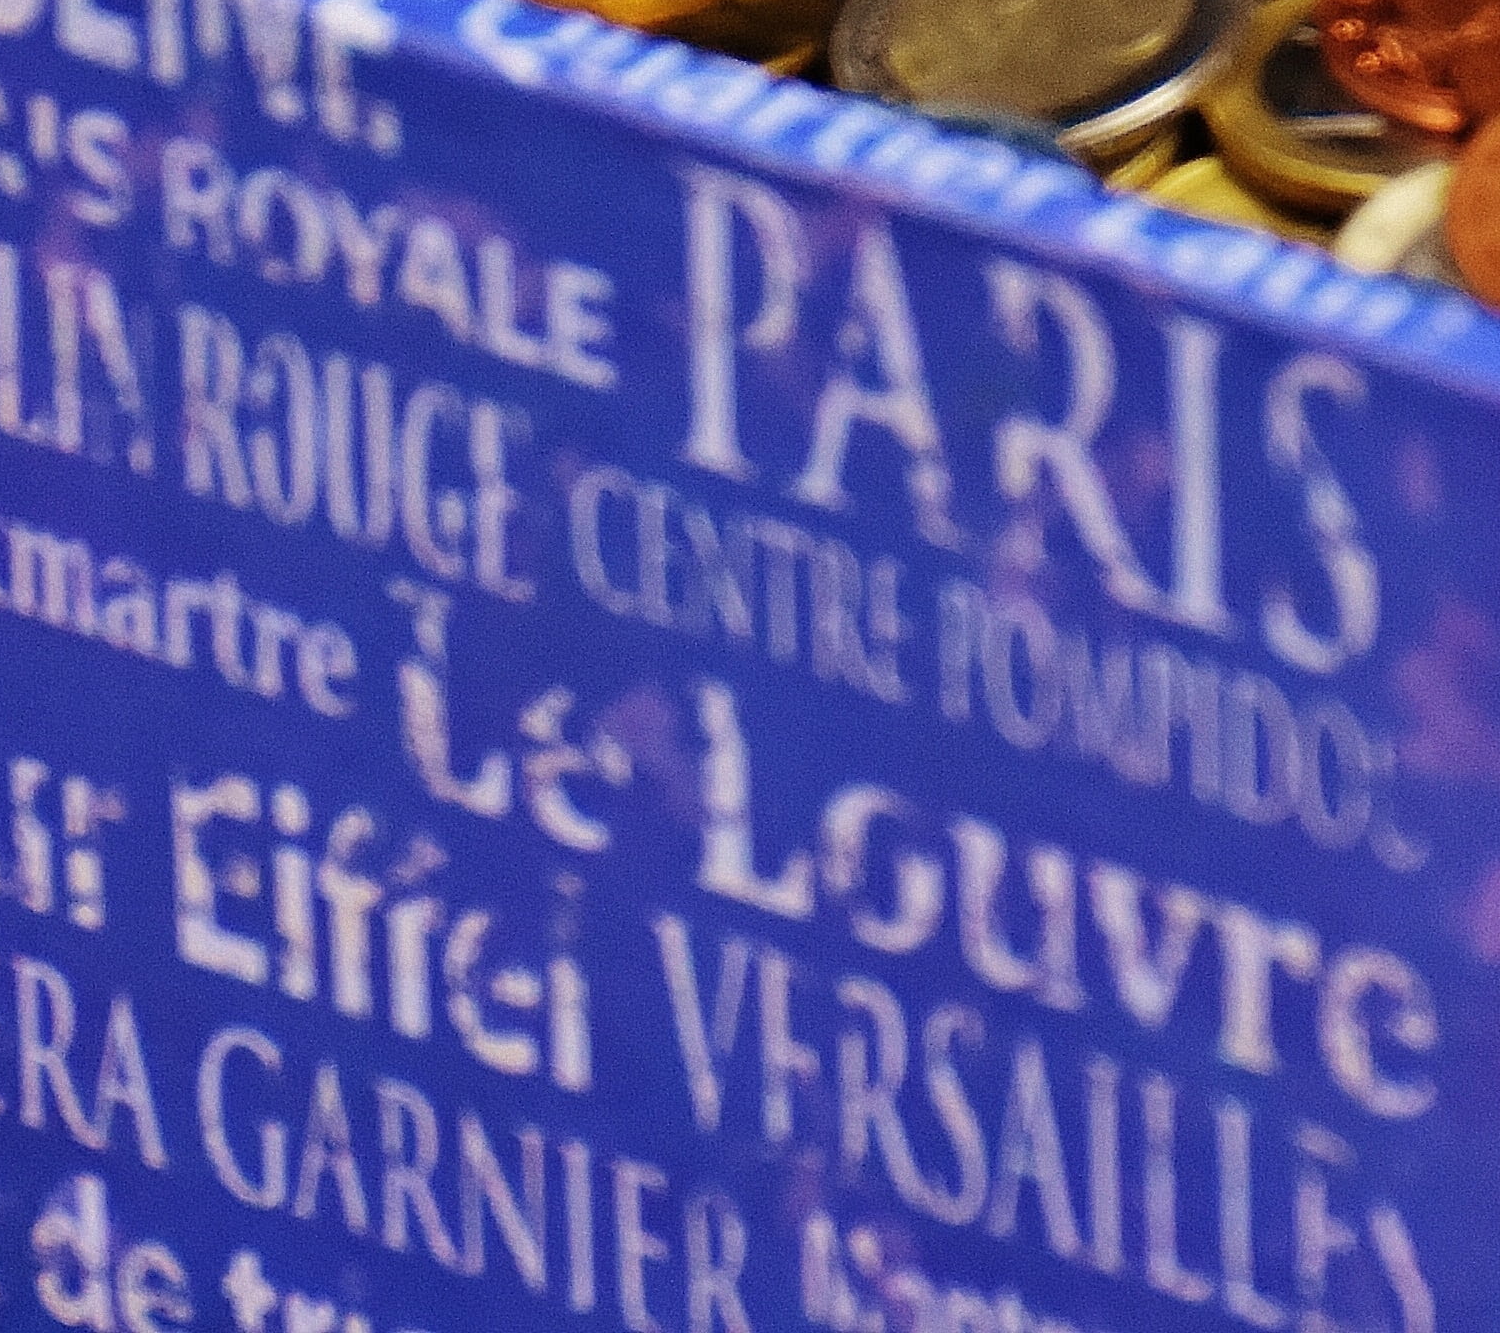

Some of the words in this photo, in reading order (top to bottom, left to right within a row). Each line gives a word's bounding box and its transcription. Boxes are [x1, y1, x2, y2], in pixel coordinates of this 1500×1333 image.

[160, 134, 618, 391] ROYALE
[180, 301, 538, 604] ROUGE
[677, 159, 1382, 674] PARIS
[565, 459, 912, 703] CENTRE
[698, 679, 1440, 1120] Louvre
[196, 1025, 752, 1333] GARNIER
